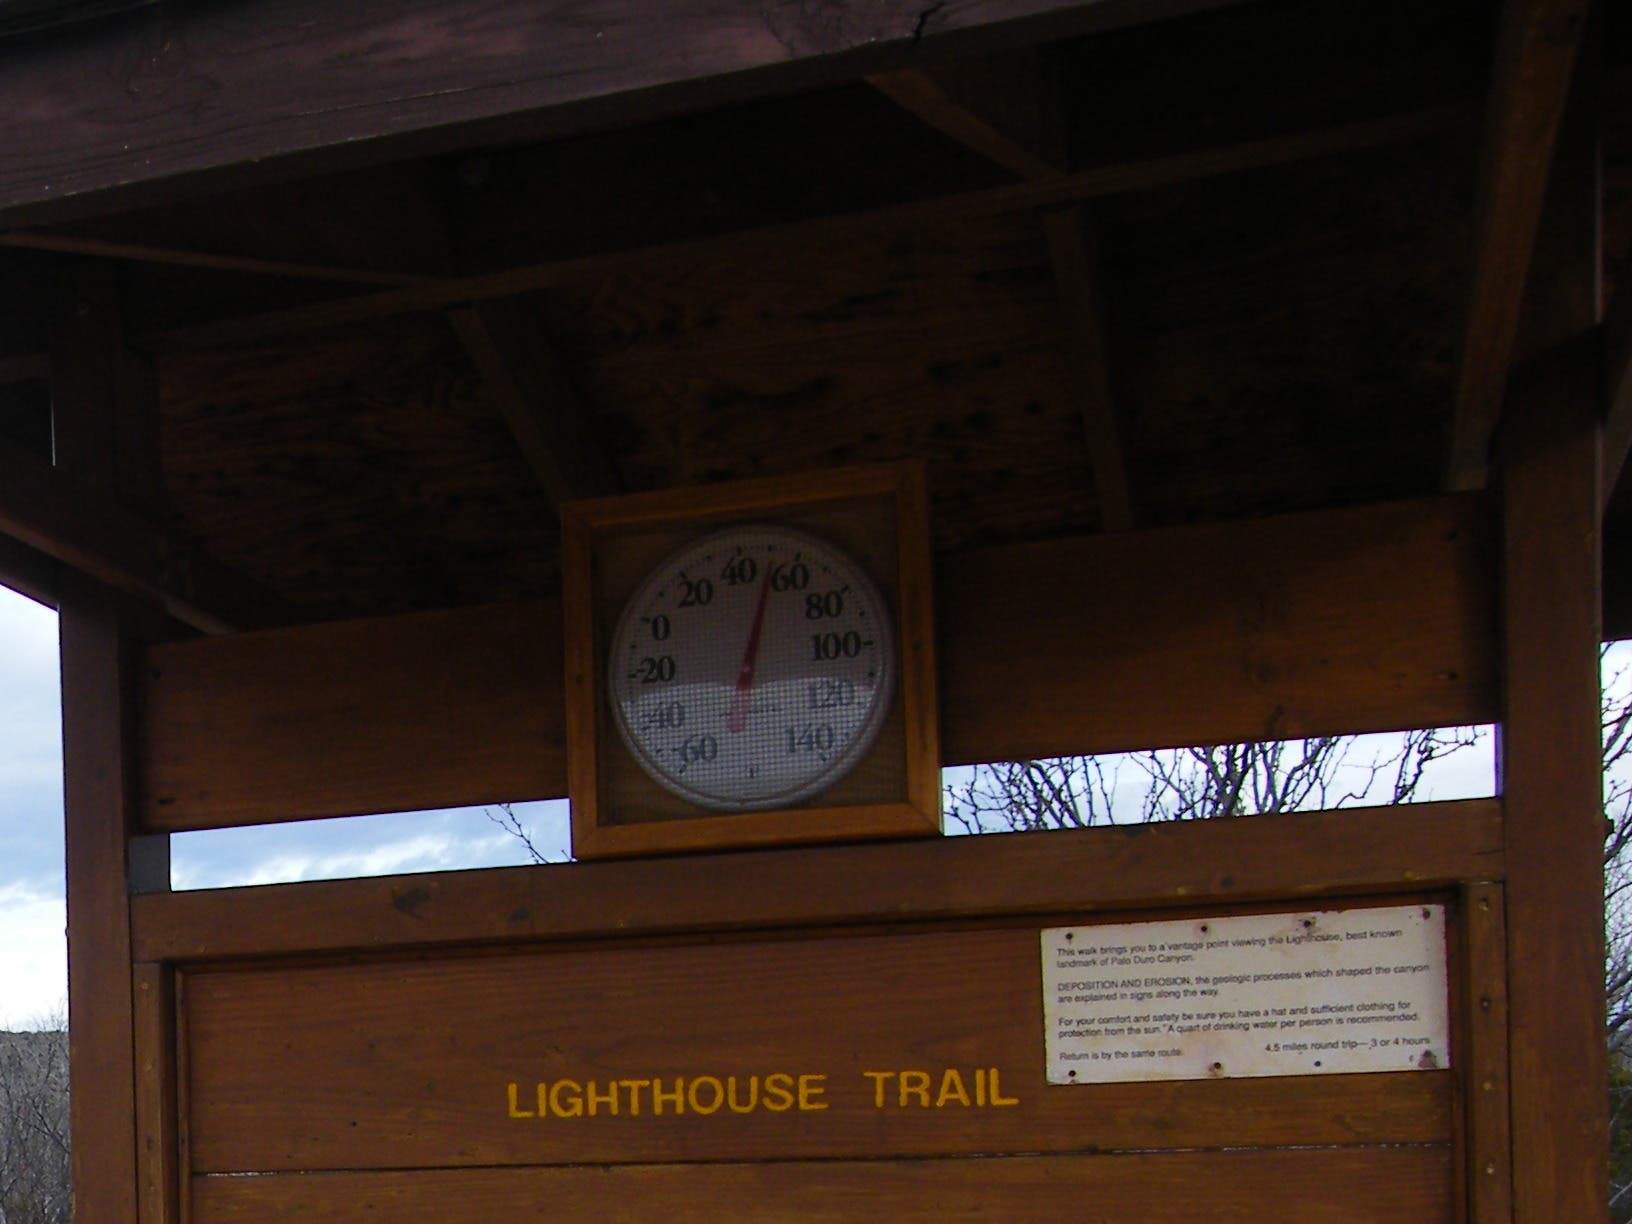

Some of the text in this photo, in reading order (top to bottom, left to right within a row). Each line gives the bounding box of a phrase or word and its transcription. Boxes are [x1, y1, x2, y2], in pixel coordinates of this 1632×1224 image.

[720, 556, 757, 586] 40
[770, 562, 810, 593] 60
[677, 577, 713, 608] 20
[805, 590, 844, 620] 80
[651, 614, 671, 641] 0
[810, 630, 861, 661] 100
[809, 680, 855, 709] 120
[785, 724, 834, 753] 140
[1058, 948, 1075, 956] This
[1078, 946, 1097, 955] walk
[1100, 945, 1127, 955] brings
[1130, 945, 1146, 954] you
[1149, 944, 1157, 952] to
[1168, 942, 1204, 952] vantage
[1207, 940, 1229, 950] point
[1232, 938, 1266, 948] viewing
[1268, 935, 1283, 944] the
[1346, 931, 1367, 940] best
[1370, 929, 1402, 938] known
[1057, 957, 1096, 968] landmark
[1099, 957, 1109, 966] of
[1111, 956, 1131, 965] Palo
[1134, 955, 1155, 964] Duro
[1058, 980, 1118, 991] DEPOSITION
[1120, 979, 1142, 988] AND
[1195, 976, 1210, 984] the
[1212, 974, 1250, 985] geologic
[1253, 971, 1302, 983] processes
[1304, 968, 1333, 978] which
[1336, 966, 1372, 978] shaped
[1375, 965, 1391, 974] the
[1393, 963, 1429, 974] canyon
[1058, 995, 1072, 1003] are
[1075, 993, 1117, 1003] explained
[1120, 991, 1127, 999] in
[1130, 991, 1153, 1001] signs
[1156, 989, 1181, 1000] along
[1183, 988, 1197, 997] the
[1058, 1017, 1073, 1026] For
[1076, 1017, 1095, 1027] your
[1097, 1015, 1132, 1025] comfort
[1133, 1014, 1150, 1023] and
[1152, 1012, 1179, 1023] safety
[1182, 1012, 1194, 1020] be
[1196, 1012, 1216, 1020] sure
[1218, 1012, 1235, 1021] you
[1238, 1009, 1260, 1018] have
[1271, 1007, 1287, 1016] hat
[1289, 1006, 1308, 1015] and
[1310, 1003, 1354, 1014] sufficient
[1356, 1001, 1396, 1013] clothing
[1398, 1000, 1410, 1009] for
[1058, 1027, 1103, 1039] protection
[1104, 1026, 1125, 1036] from
[1127, 1026, 1141, 1035] the
[1168, 1024, 1175, 1032] A
[1177, 1023, 1200, 1034] quart
[1202, 1022, 1212, 1031] of
[1213, 1020, 1250, 1031] drinking
[1253, 1019, 1277, 1028] water
[1280, 1020, 1295, 1029] per
[1299, 1017, 1333, 1027] person
[1335, 1016, 1344, 1024] is
[1059, 1052, 1090, 1061] Return
[1092, 1051, 1099, 1059] is
[1101, 1051, 1112, 1060] by
[1114, 1050, 1129, 1058] the
[1131, 1050, 1155, 1058] same
[1282, 1041, 1308, 1051] miles
[1310, 1040, 1339, 1050] round
[1371, 1038, 1377, 1048] 3
[1379, 1038, 1391, 1047] or
[1393, 1037, 1400, 1046] 4
[507, 1067, 1021, 1119] LIGHTHOUSE TRAIL
